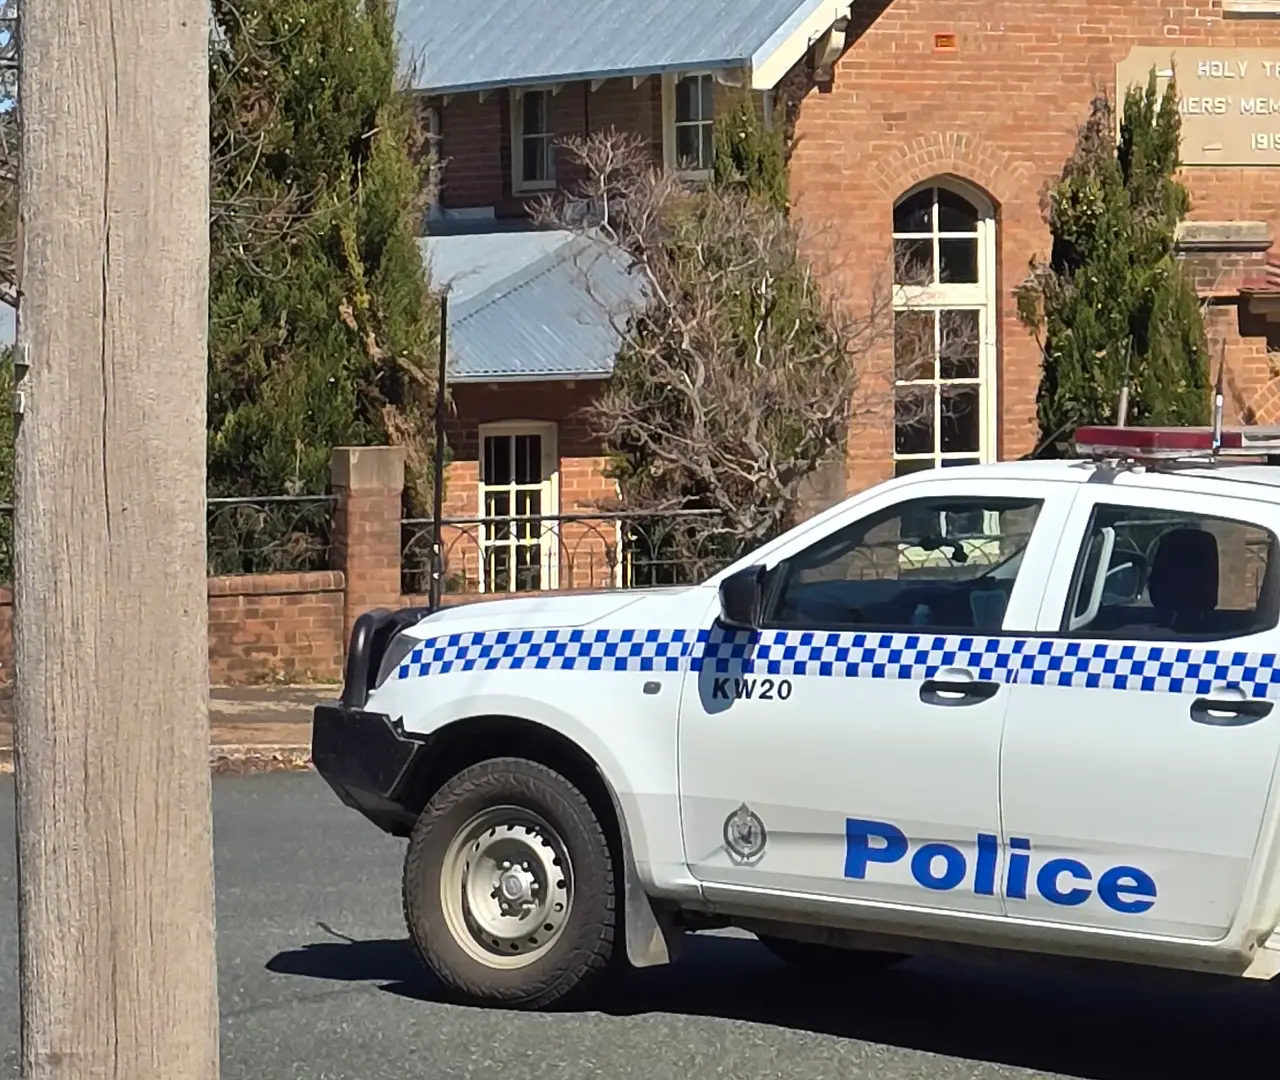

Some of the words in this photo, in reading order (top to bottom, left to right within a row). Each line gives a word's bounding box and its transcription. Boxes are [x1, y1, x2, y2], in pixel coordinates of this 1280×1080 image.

[1198, 60, 1248, 79] HOLY
[712, 677, 793, 701] KW20
[844, 817, 1157, 915] Police
